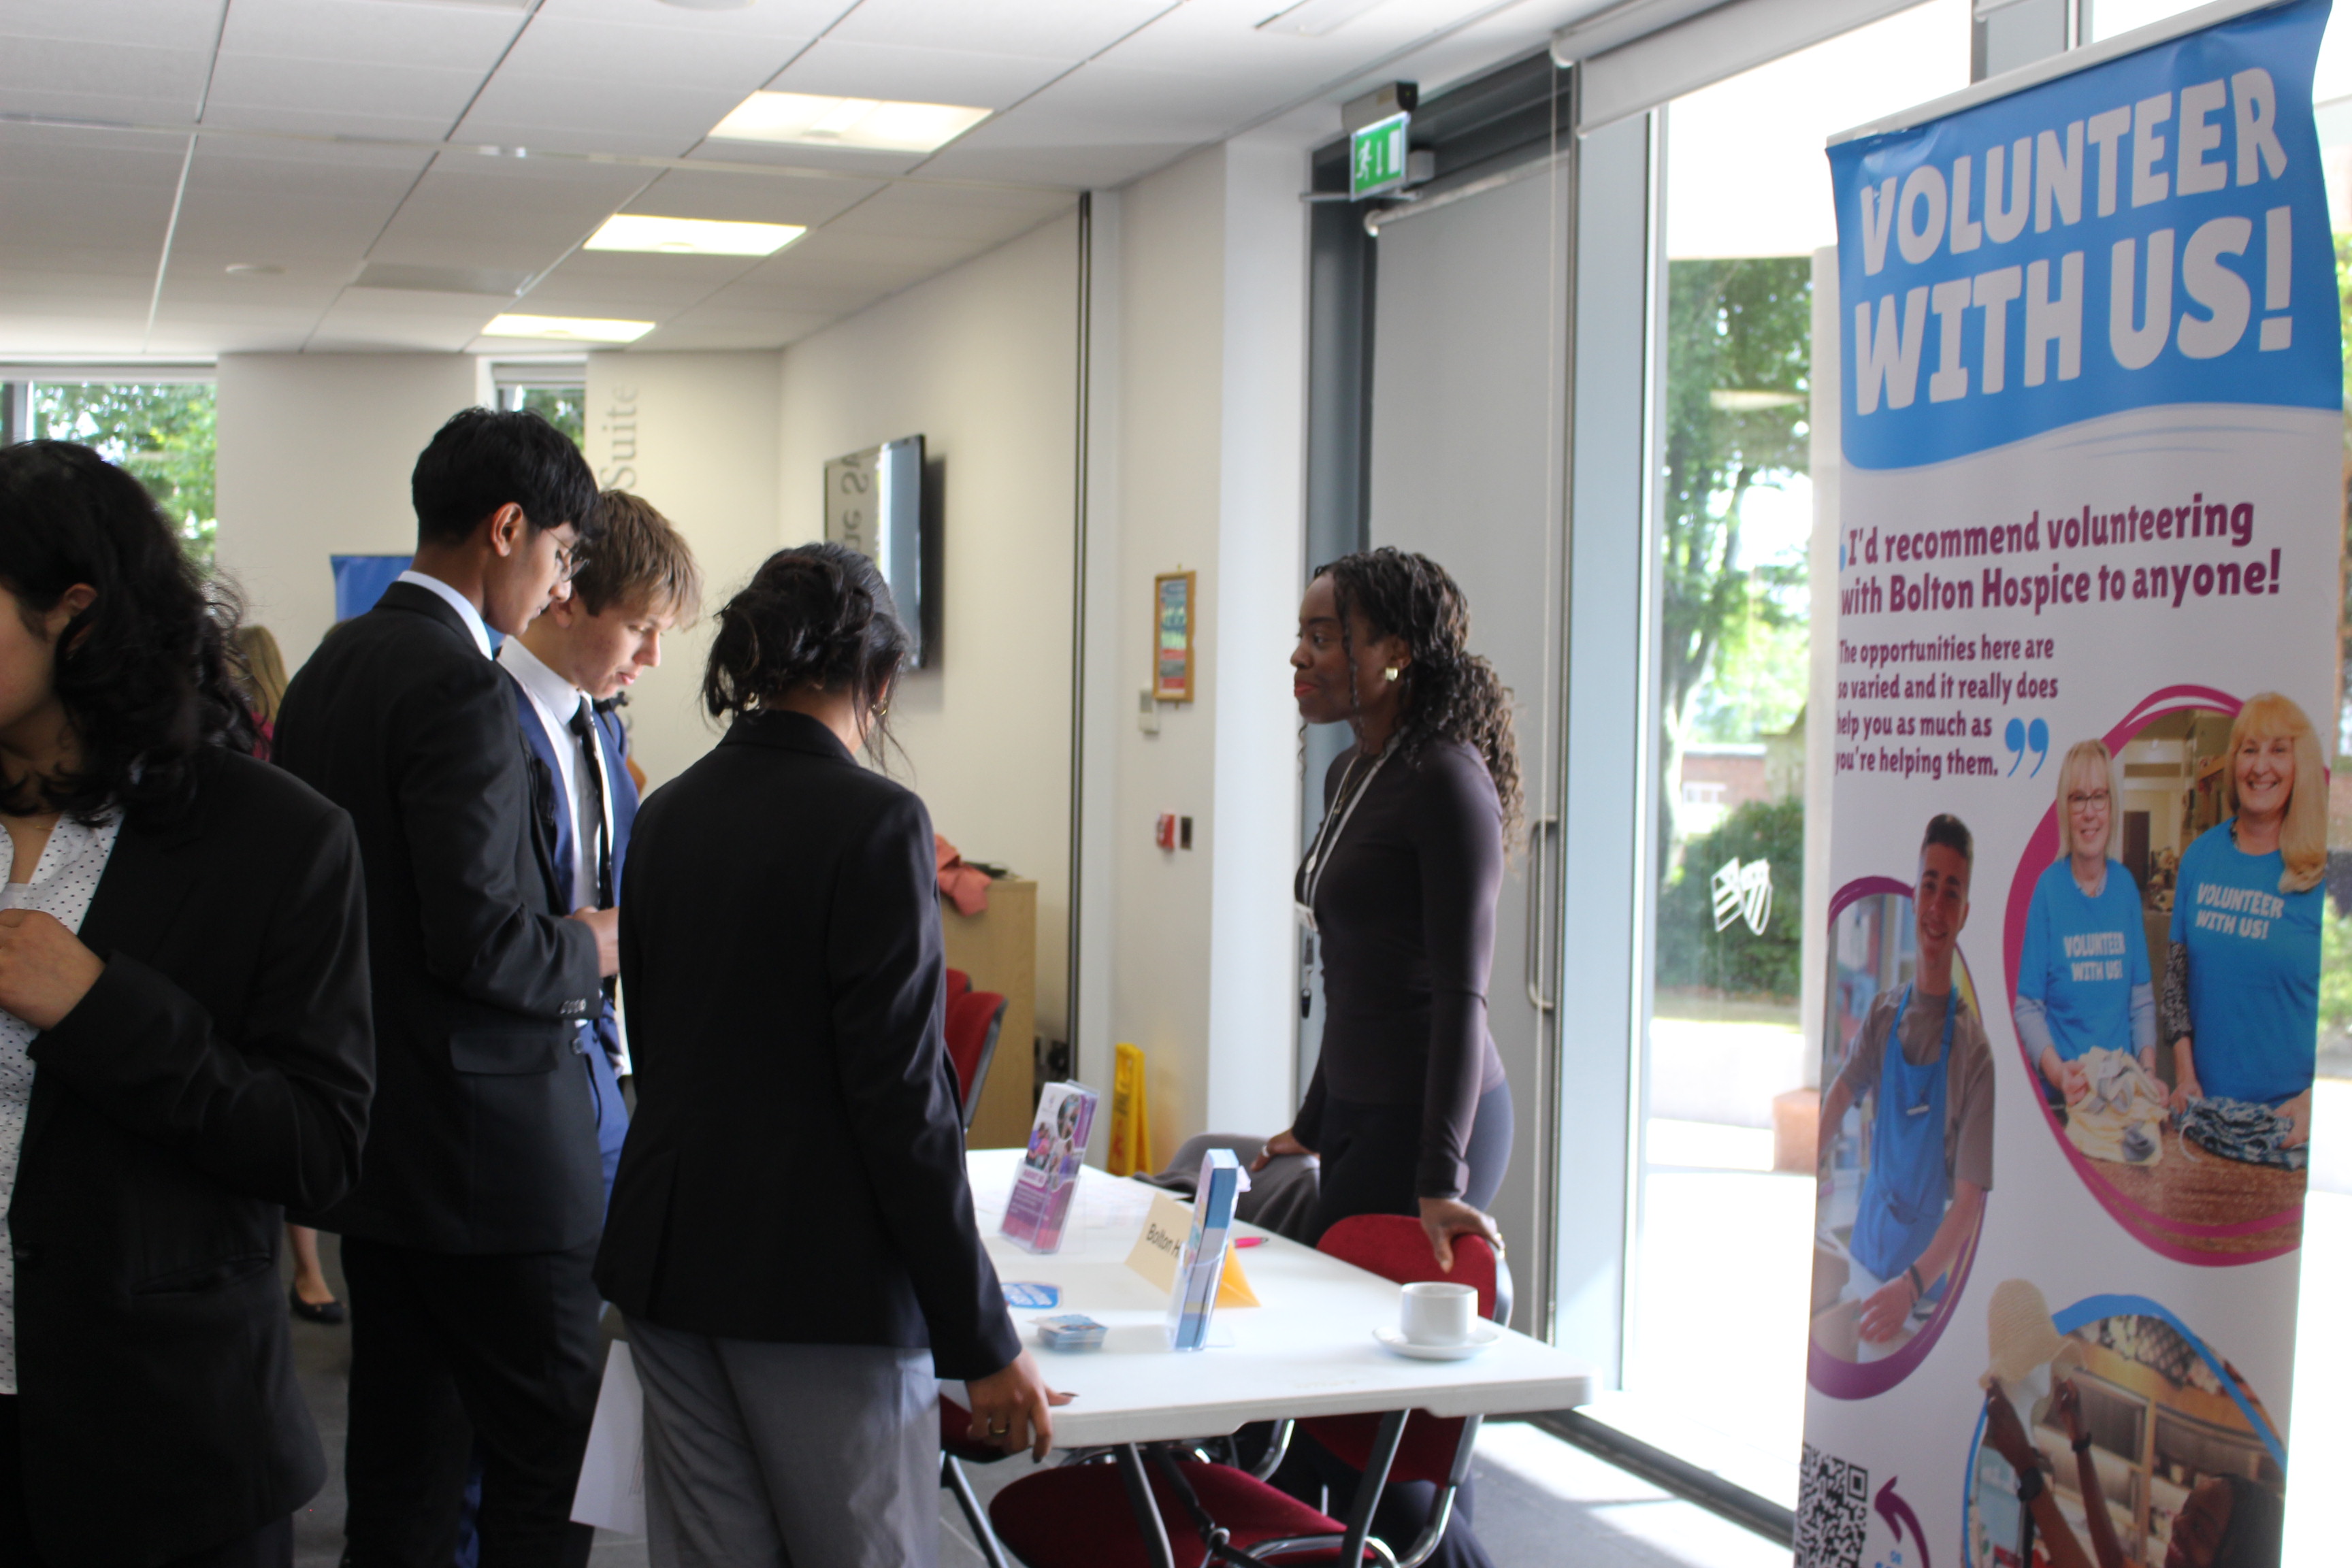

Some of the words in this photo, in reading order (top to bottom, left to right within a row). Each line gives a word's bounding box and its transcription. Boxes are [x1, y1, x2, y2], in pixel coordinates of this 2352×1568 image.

[1860, 67, 2288, 276] VOLUNTEER
[1855, 250, 2084, 416] WITH
[2109, 205, 2293, 370] US!
[599, 384, 638, 489] Suite
[1848, 525, 1878, 566] I'd
[1885, 510, 2040, 563] recommend
[2047, 492, 2254, 549] volunteering
[1842, 576, 1882, 616] with
[1890, 572, 1974, 612] Bolton
[1982, 562, 2090, 615] Hospice
[2098, 564, 2125, 602] to
[2133, 547, 2282, 608] anyone!
[1840, 638, 1857, 664] The
[1861, 634, 1976, 669] opportunities
[1981, 633, 2021, 660] here
[2025, 638, 2054, 659] are
[1838, 681, 1848, 699] so
[1851, 672, 1899, 700] varied
[1905, 672, 1936, 699] and
[1941, 672, 1954, 699] it
[1959, 671, 2012, 706] really
[2016, 670, 2058, 699] does
[1838, 709, 1859, 741] help
[1863, 716, 1892, 741] you
[1897, 717, 1916, 736] as
[1920, 709, 1967, 737] much
[1972, 717, 1993, 737] as
[1835, 745, 1876, 777] you're
[1879, 745, 1942, 781] helping
[1947, 747, 1999, 777] them.
[2197, 882, 2285, 919] VOLUNTEER
[2195, 909, 2238, 935] WITH
[2238, 917, 2270, 940] US!
[2063, 932, 2126, 958] VOLUNTEER
[2071, 961, 2104, 982] WITH
[1146, 1223, 1173, 1254] Bolton
